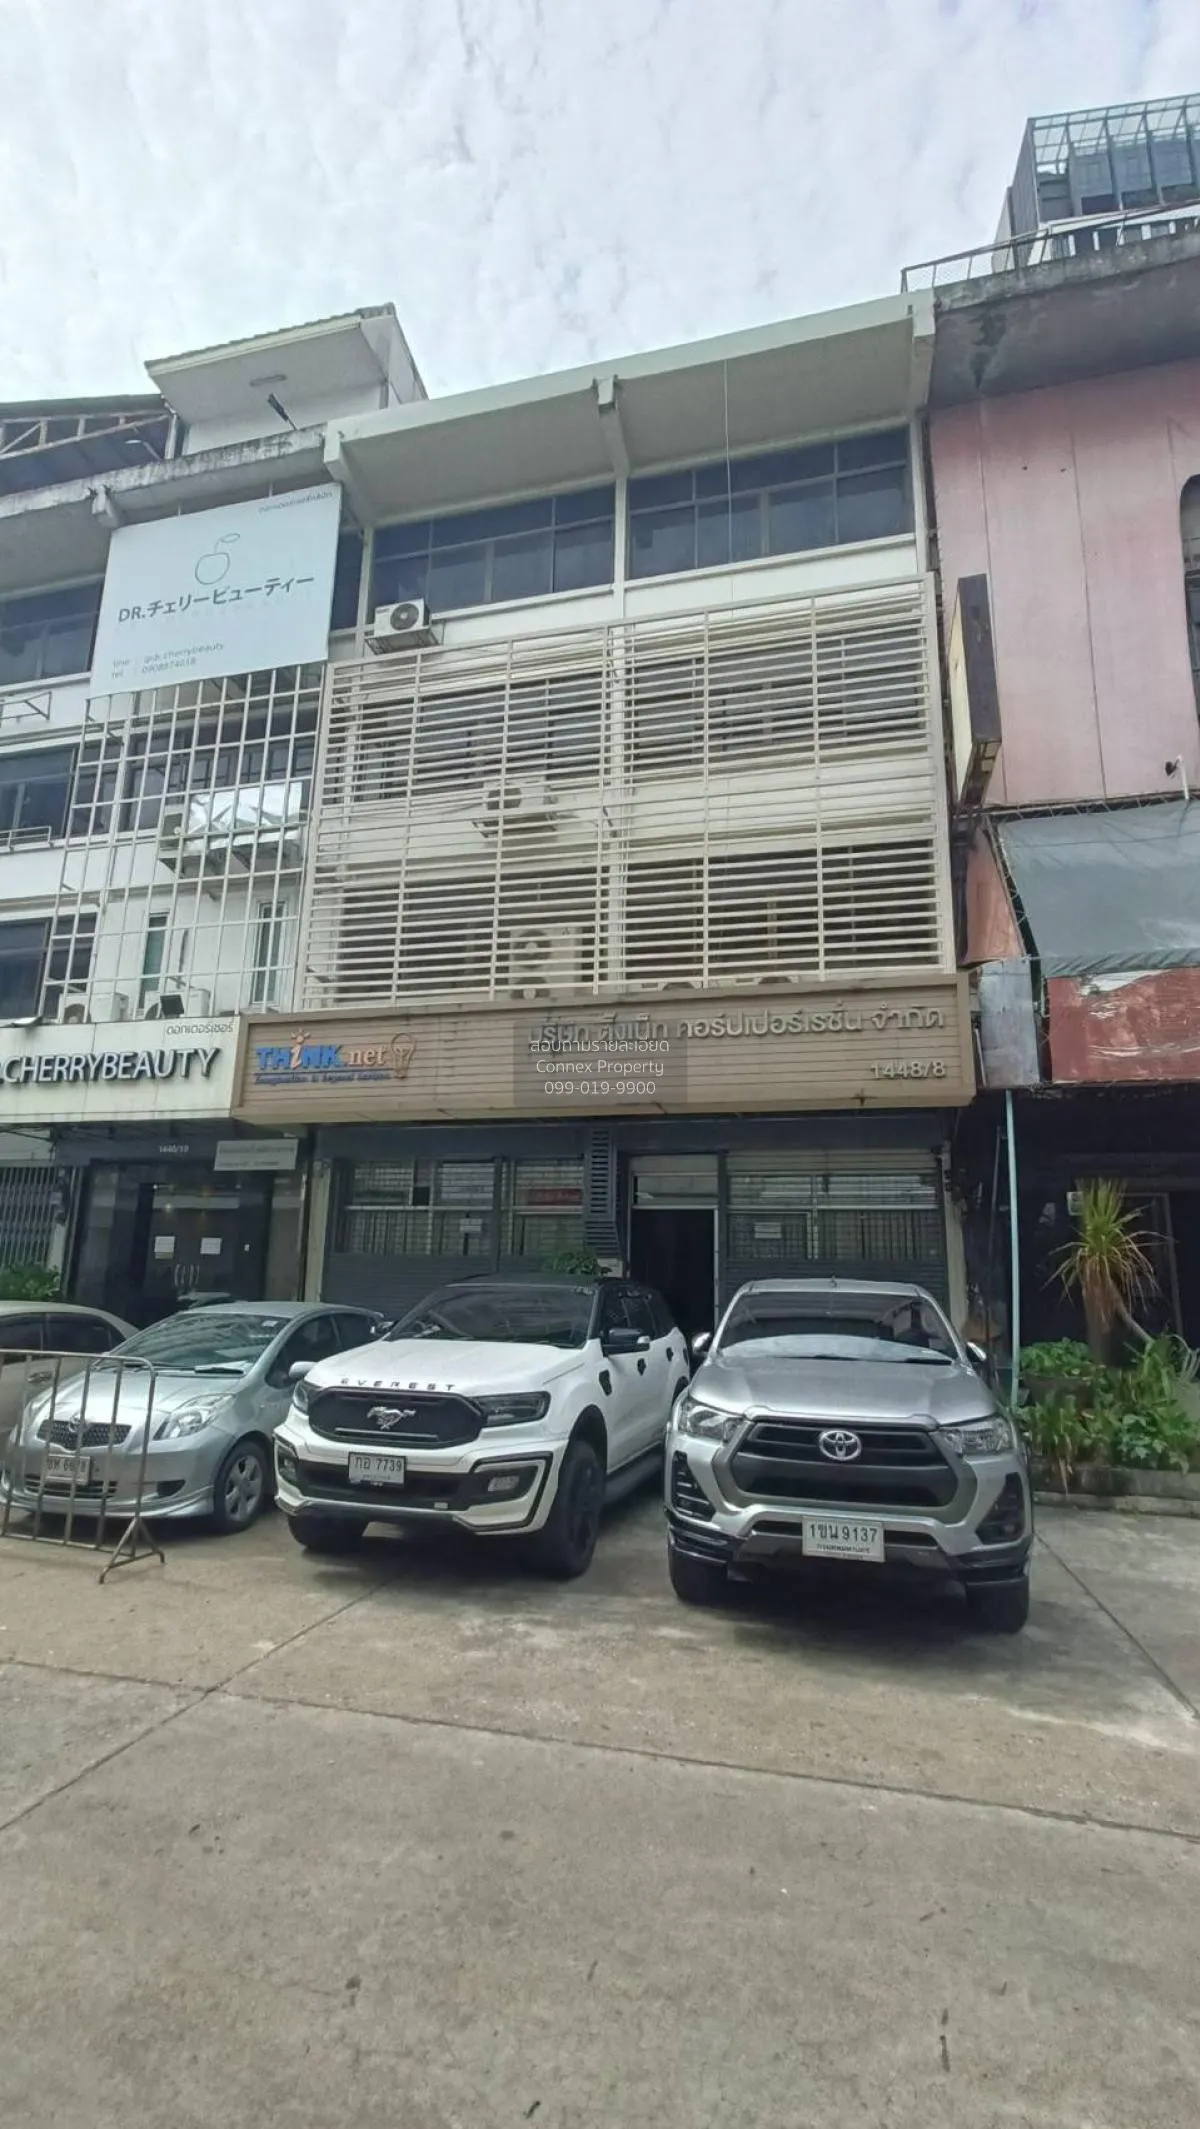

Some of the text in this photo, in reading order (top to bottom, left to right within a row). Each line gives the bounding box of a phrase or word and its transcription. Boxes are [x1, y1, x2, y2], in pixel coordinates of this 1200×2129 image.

[871, 1000, 944, 1030] จำกัด
[870, 1060, 947, 1079] 1448/8
[341, 1378, 456, 1391] EVEREST
[376, 1458, 402, 1472] 7739
[842, 1526, 878, 1543] 9137
